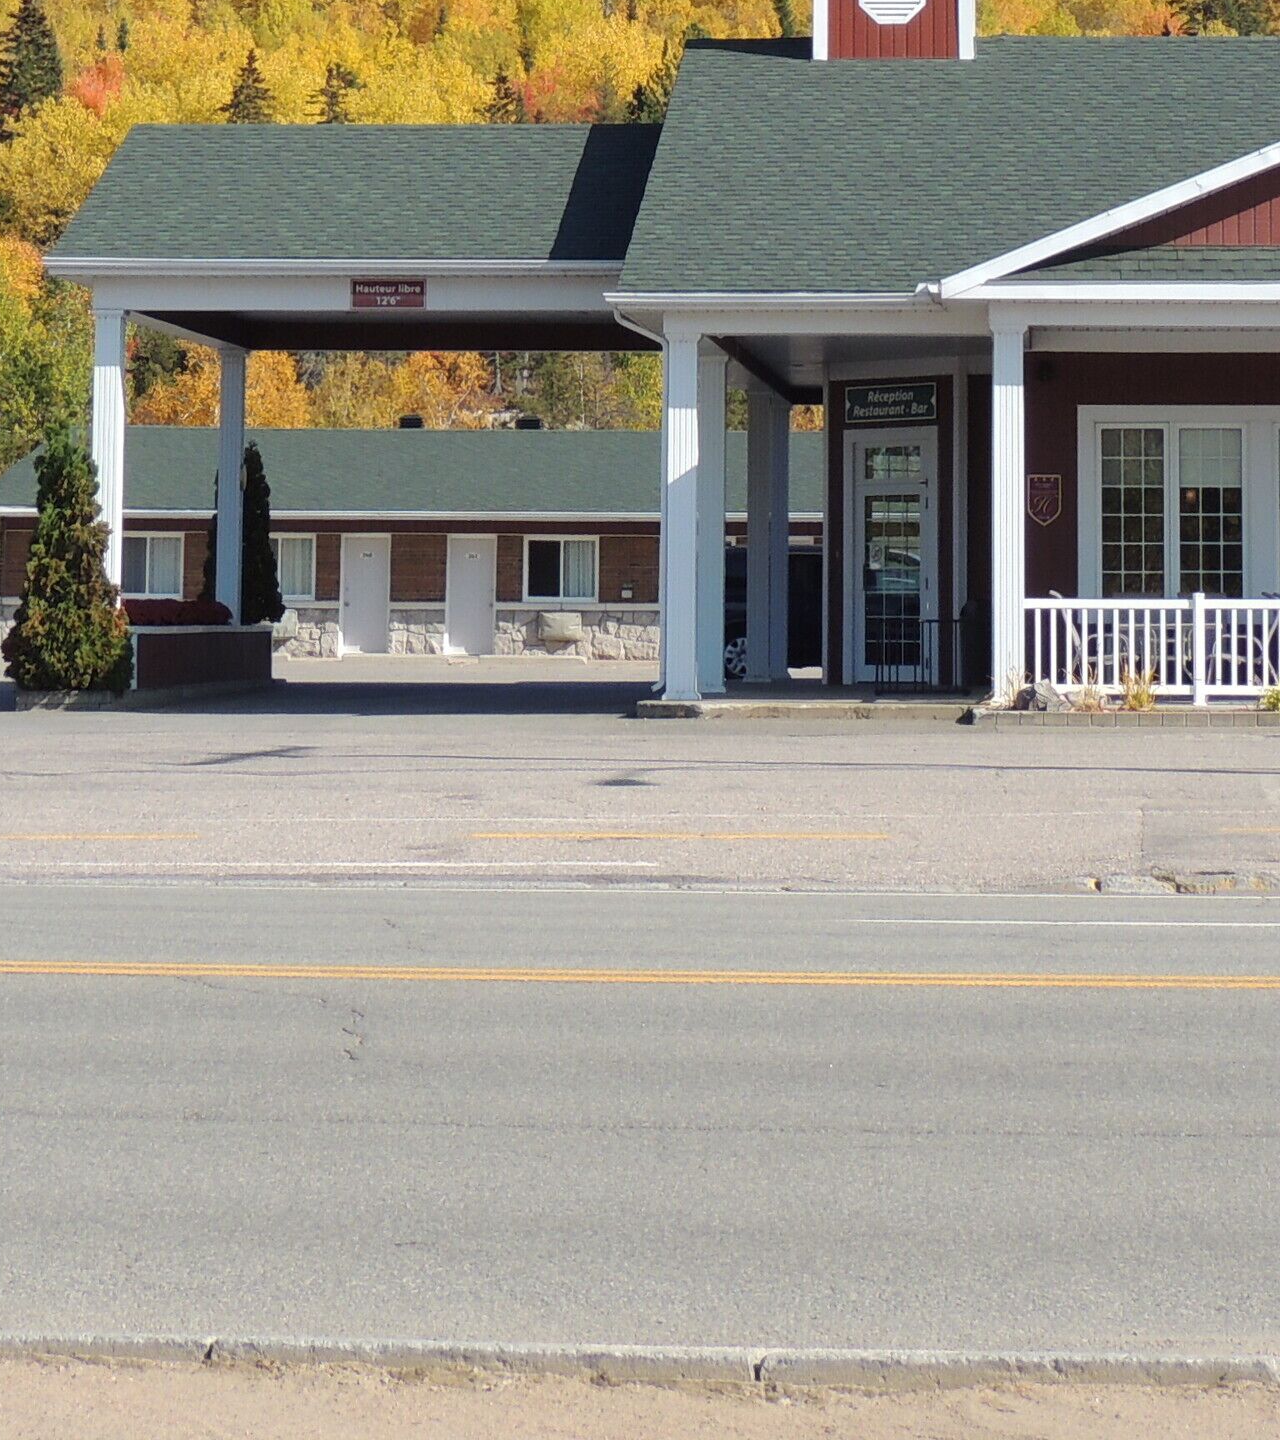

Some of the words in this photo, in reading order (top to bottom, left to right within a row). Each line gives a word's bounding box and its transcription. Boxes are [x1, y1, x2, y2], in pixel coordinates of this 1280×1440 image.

[355, 284, 396, 294] Hauteur
[399, 283, 421, 293] libre
[867, 390, 914, 404] Réception
[853, 404, 906, 418] Restaurant
[911, 402, 928, 414] Bar
